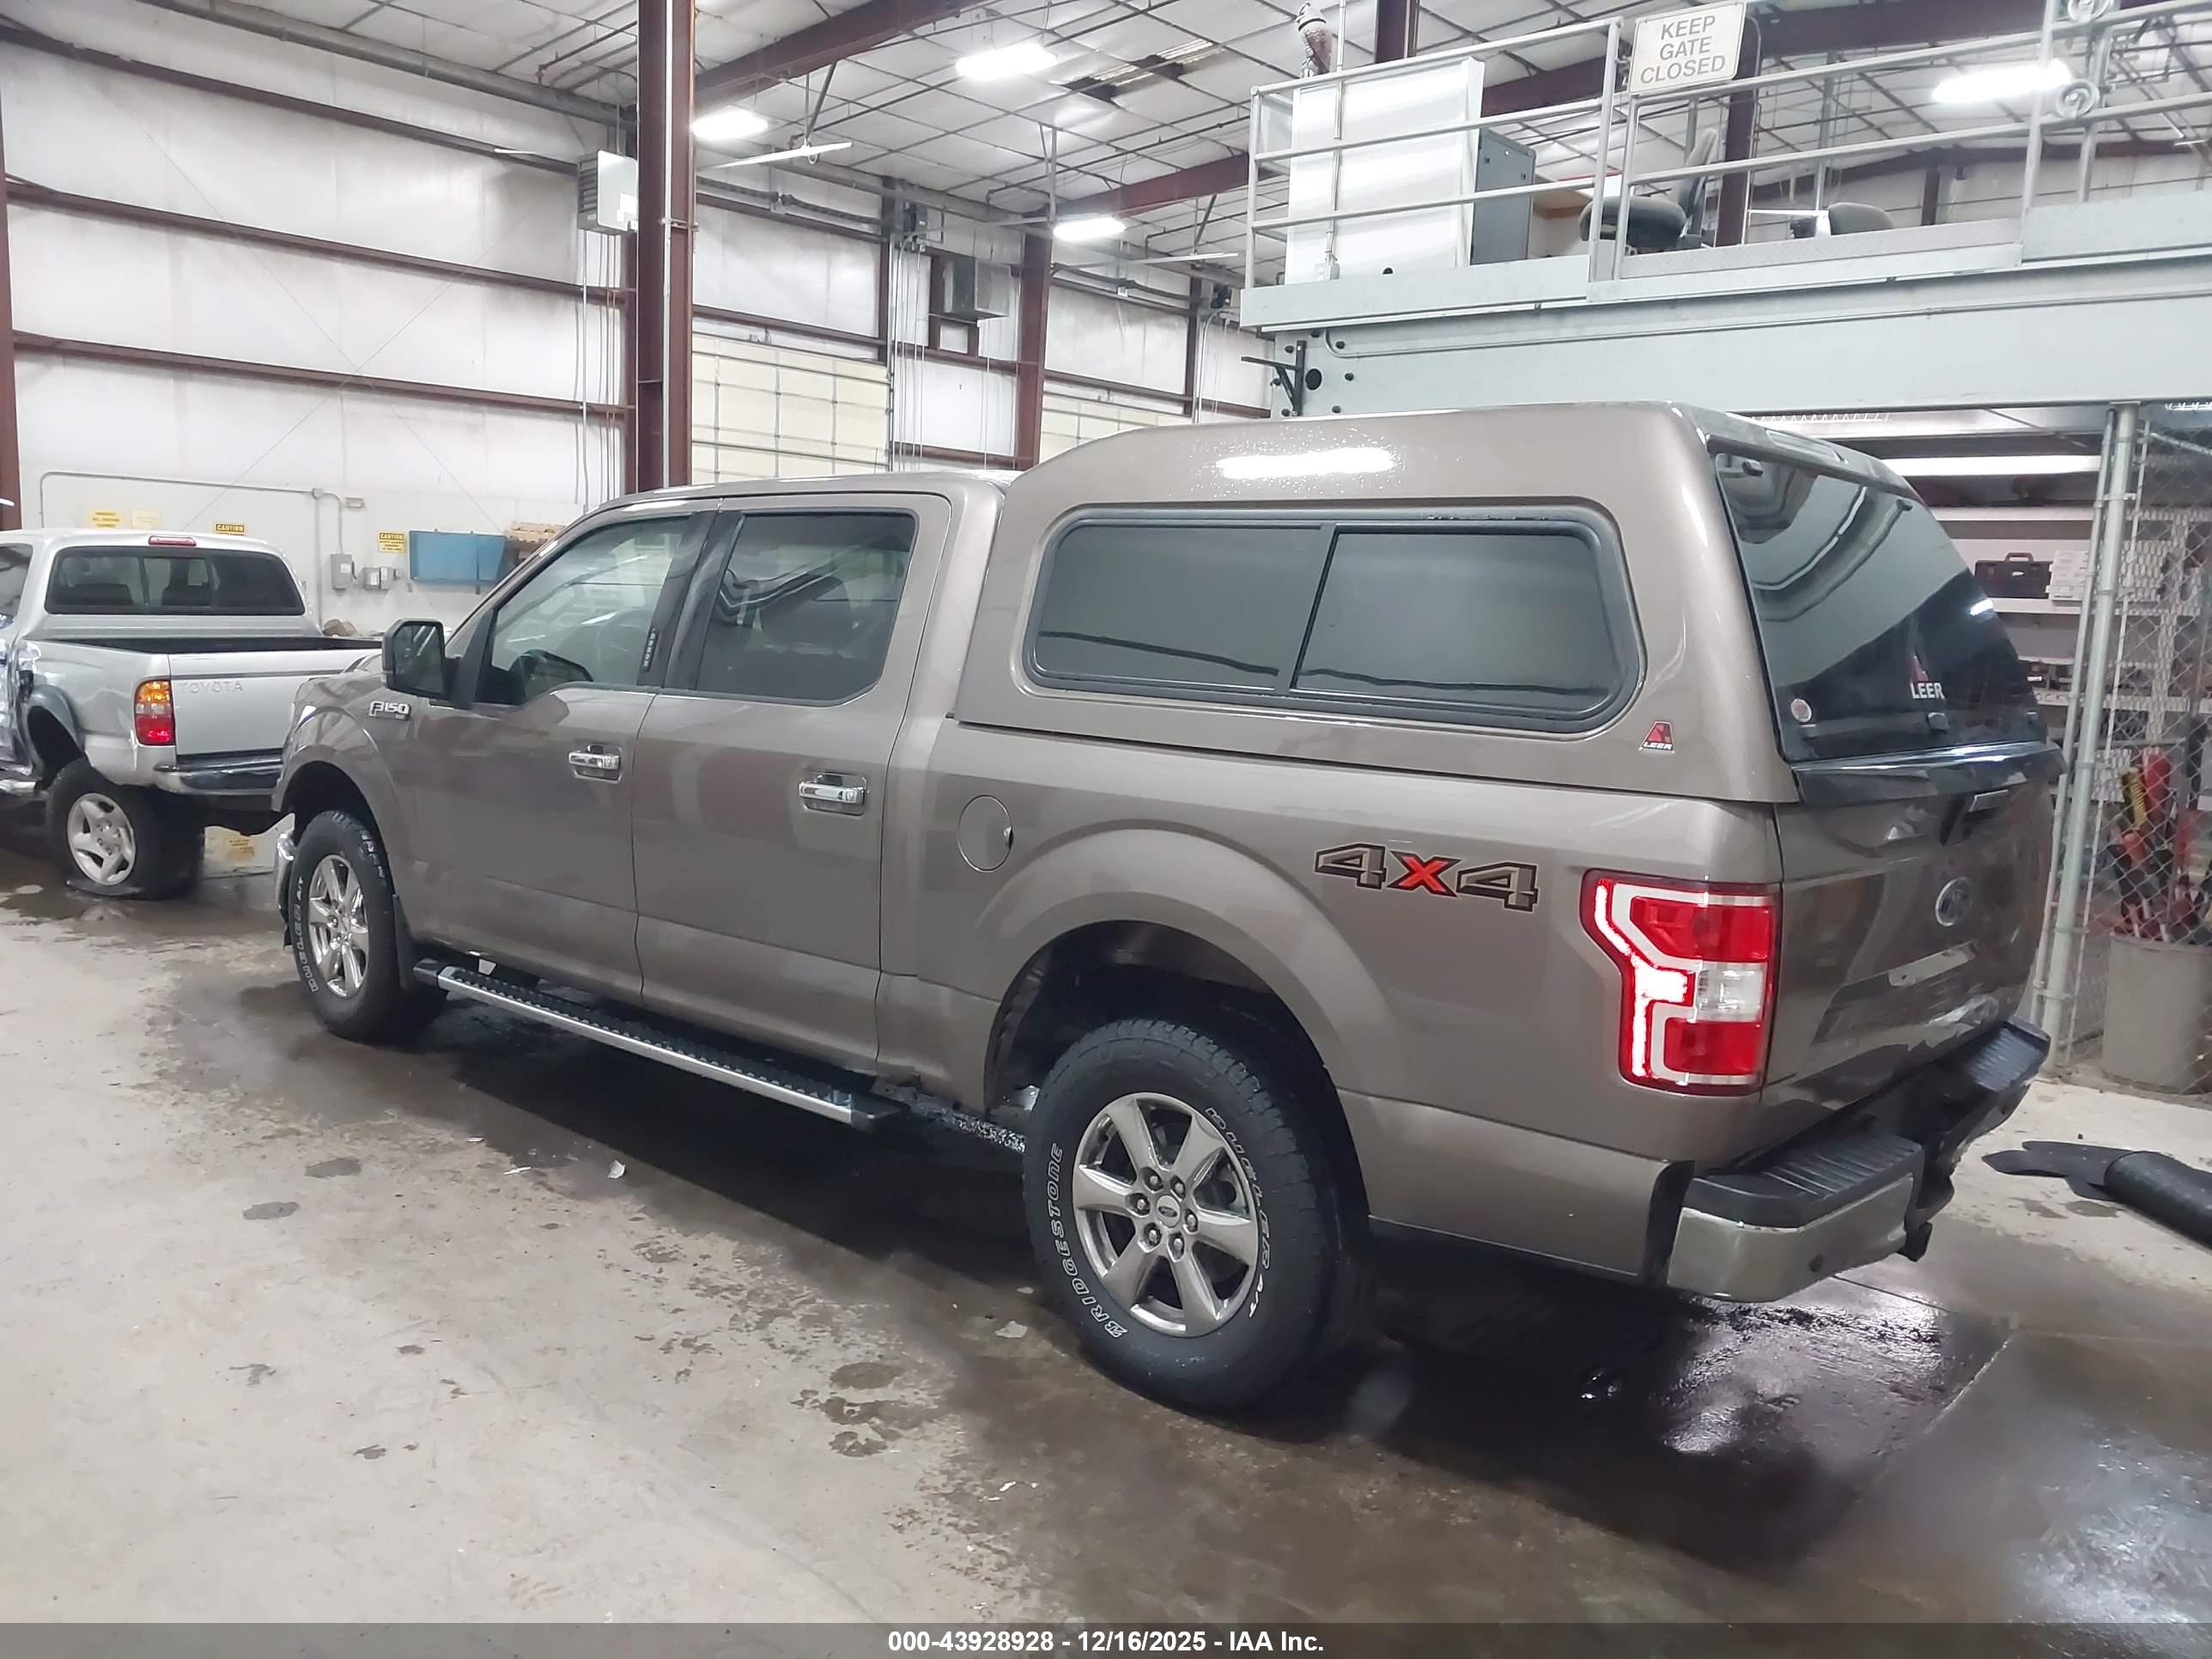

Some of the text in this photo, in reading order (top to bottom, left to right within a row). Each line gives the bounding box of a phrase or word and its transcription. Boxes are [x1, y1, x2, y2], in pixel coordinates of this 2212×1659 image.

[1661, 15, 1716, 40] KEEP
[1660, 36, 1712, 60] GATE
[1640, 55, 1725, 83] CLOSED
[179, 680, 244, 694] TOYOTA
[1910, 682, 1946, 700] LEER
[1642, 741, 1673, 750] LEER
[1047, 1142, 1128, 1338] BRIDGESTONE
